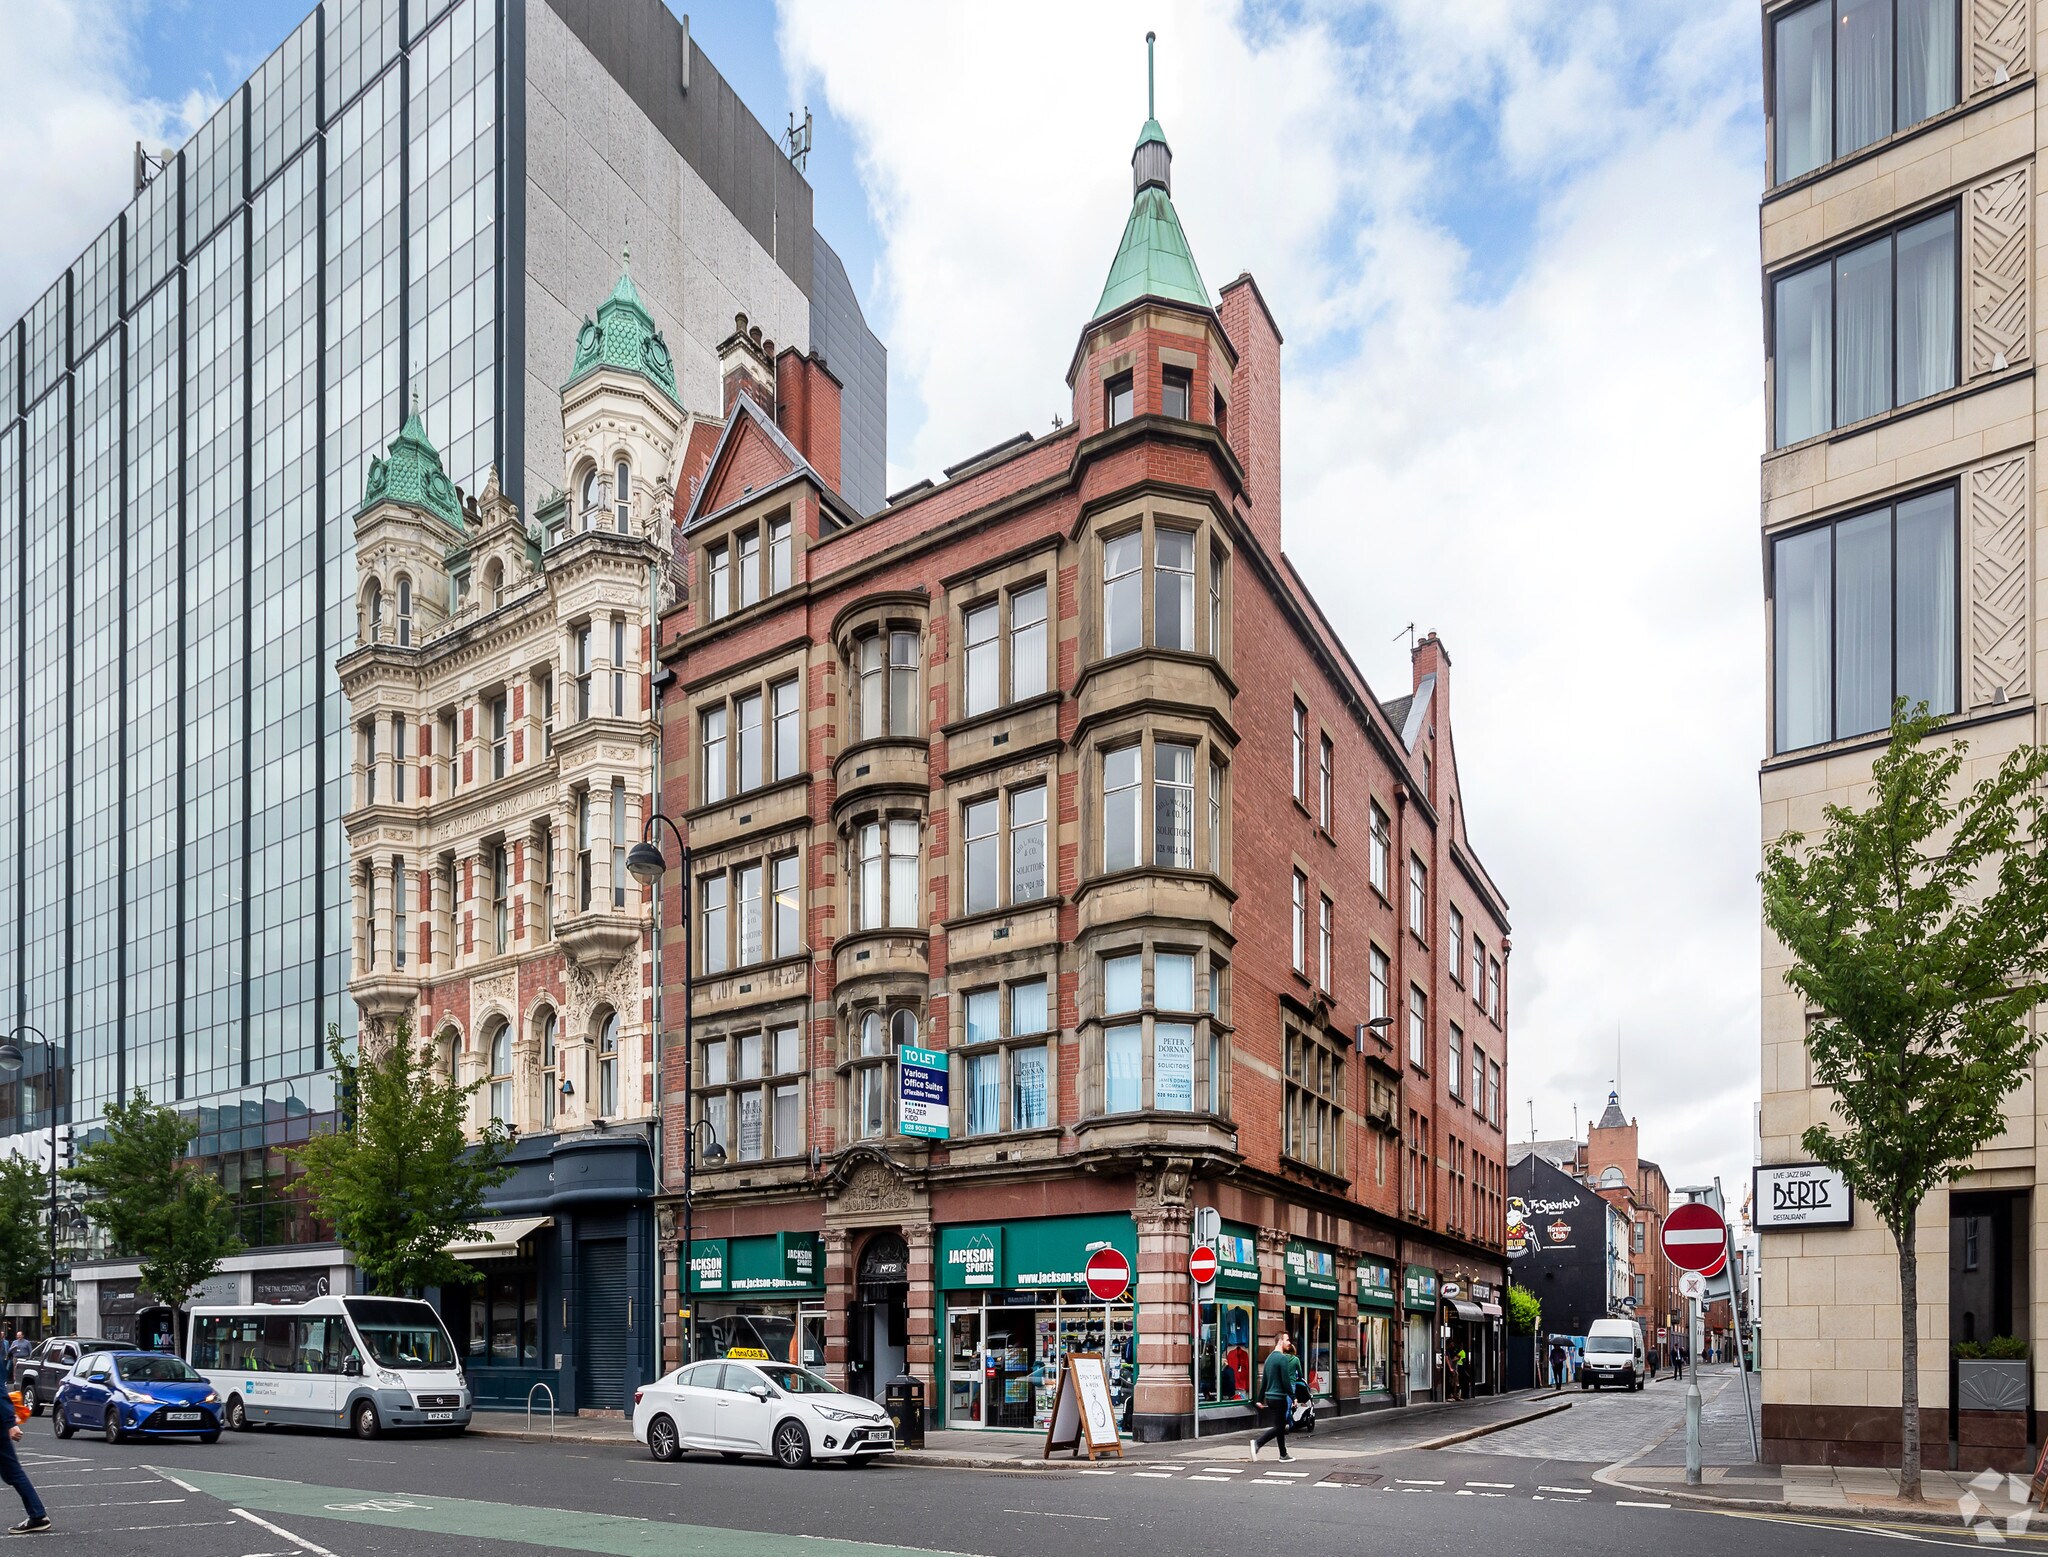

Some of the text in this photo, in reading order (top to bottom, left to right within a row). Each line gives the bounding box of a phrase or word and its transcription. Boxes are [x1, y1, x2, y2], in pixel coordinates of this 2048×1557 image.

[1156, 826, 1191, 837] SOLICITORS
[1016, 862, 1045, 876] SOLICITORS
[1163, 1038, 1185, 1046] PETER
[1158, 1045, 1190, 1054] DORNAN
[904, 1049, 936, 1065] TO LET
[1021, 1061, 1041, 1069] PETER
[1158, 1062, 1190, 1070] SOLICITORS
[904, 1068, 929, 1080] Various
[1020, 1067, 1045, 1076] ORNAN
[904, 1078, 943, 1093] Office Suites
[904, 1089, 940, 1100] (Flexible Terms)
[904, 1107, 927, 1117] FRAZER
[904, 1114, 919, 1122] KIDD
[904, 1123, 915, 1131] 028
[1773, 1172, 1784, 1180] LIVE
[1785, 1171, 1799, 1179] JAZZ
[1773, 1179, 1832, 1211] BERTS
[843, 1197, 911, 1212] BUILDINGS
[1535, 1195, 1580, 1215] Spaniard
[1773, 1213, 1807, 1221] RESTAURANT
[1547, 1225, 1572, 1233] Havana
[787, 1249, 813, 1260] JACKSON
[948, 1248, 994, 1264] JACKSON
[690, 1257, 722, 1271] ACKSON
[796, 1259, 812, 1267] SPORTS
[965, 1262, 994, 1273] SPORTS
[700, 1269, 722, 1279] SPORTS
[731, 1278, 807, 1289] www.jackson-sports.com
